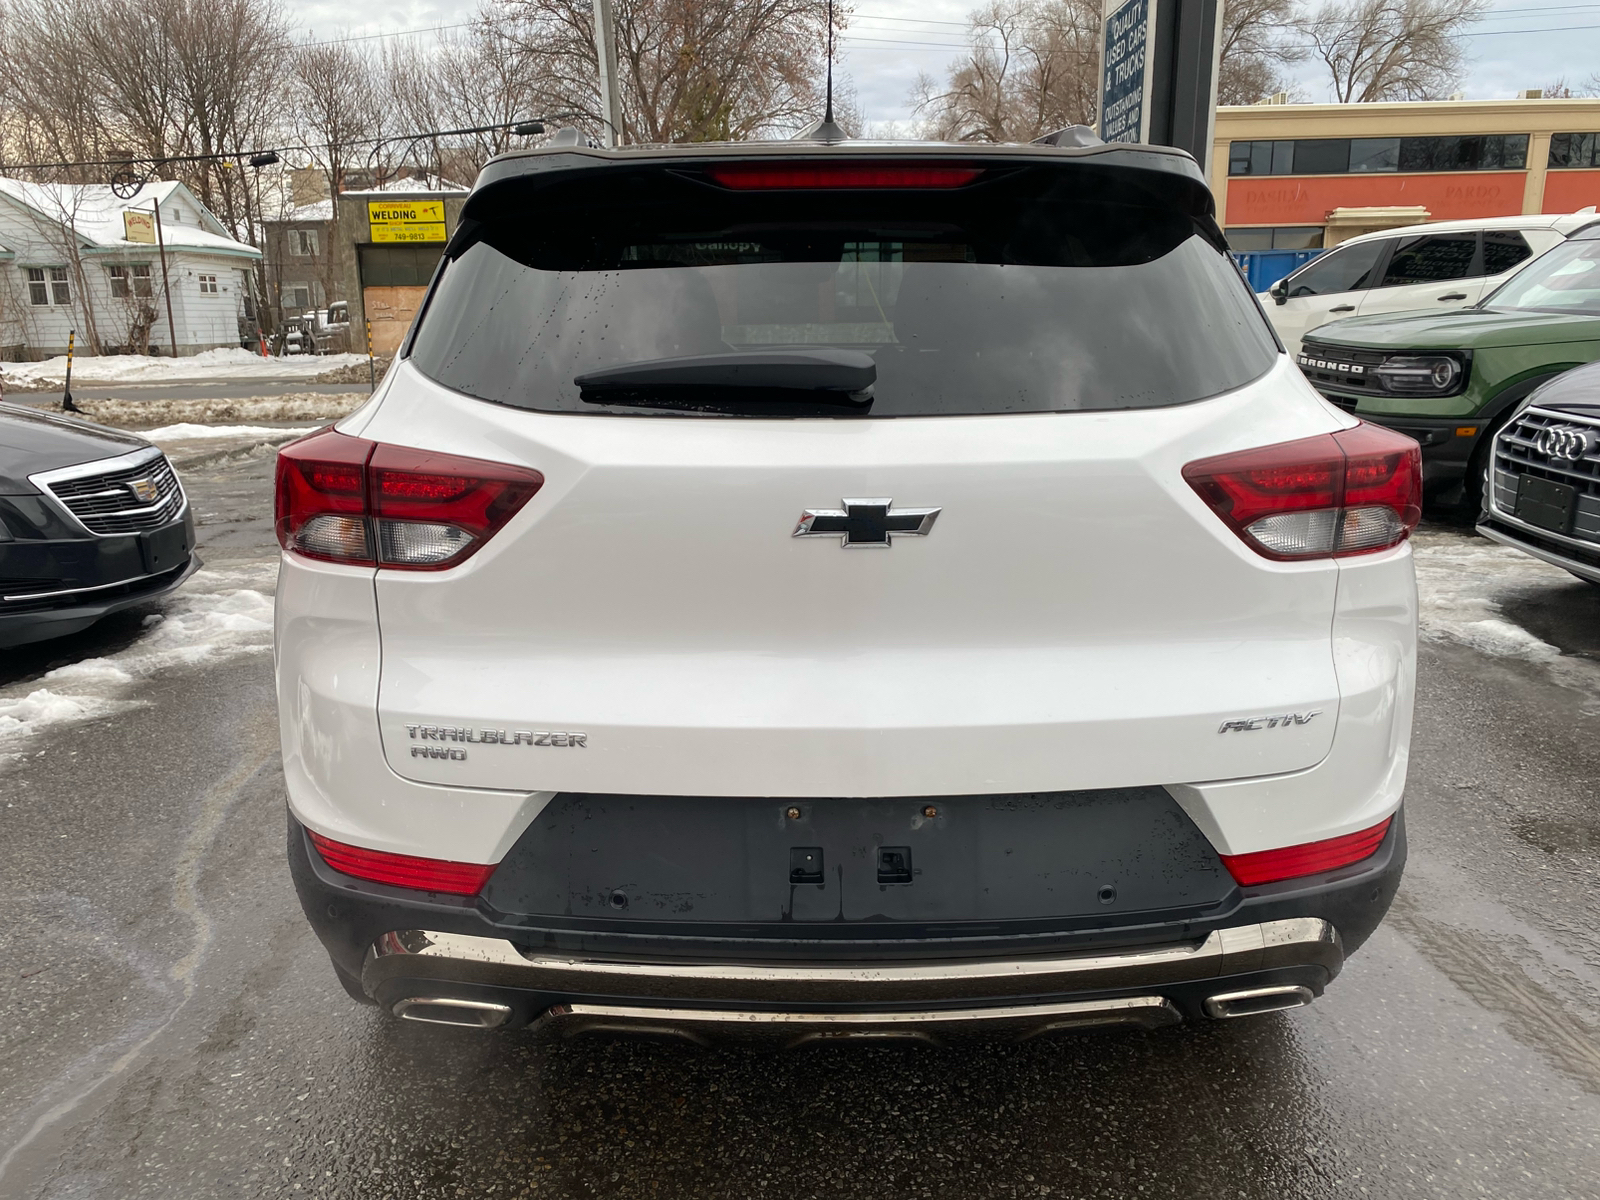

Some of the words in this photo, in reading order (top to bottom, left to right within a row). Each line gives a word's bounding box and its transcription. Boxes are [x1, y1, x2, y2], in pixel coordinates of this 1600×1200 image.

[1113, 1, 1143, 40] QUALITY
[1106, 39, 1126, 68] USED
[1128, 19, 1147, 52] CARS
[1105, 71, 1111, 91] &
[1115, 45, 1145, 86] TRUCKS
[1105, 86, 1142, 122] OUTSTANDING
[1106, 114, 1126, 138] VALUES
[1128, 107, 1140, 126] AND
[127, 216, 151, 229] WELDING
[372, 210, 416, 220] WELDING
[1300, 357, 1364, 374] BRONCO
[1217, 708, 1323, 734] ACTIV
[403, 722, 587, 748] TRAILBLAZER
[410, 744, 467, 761] AWD
